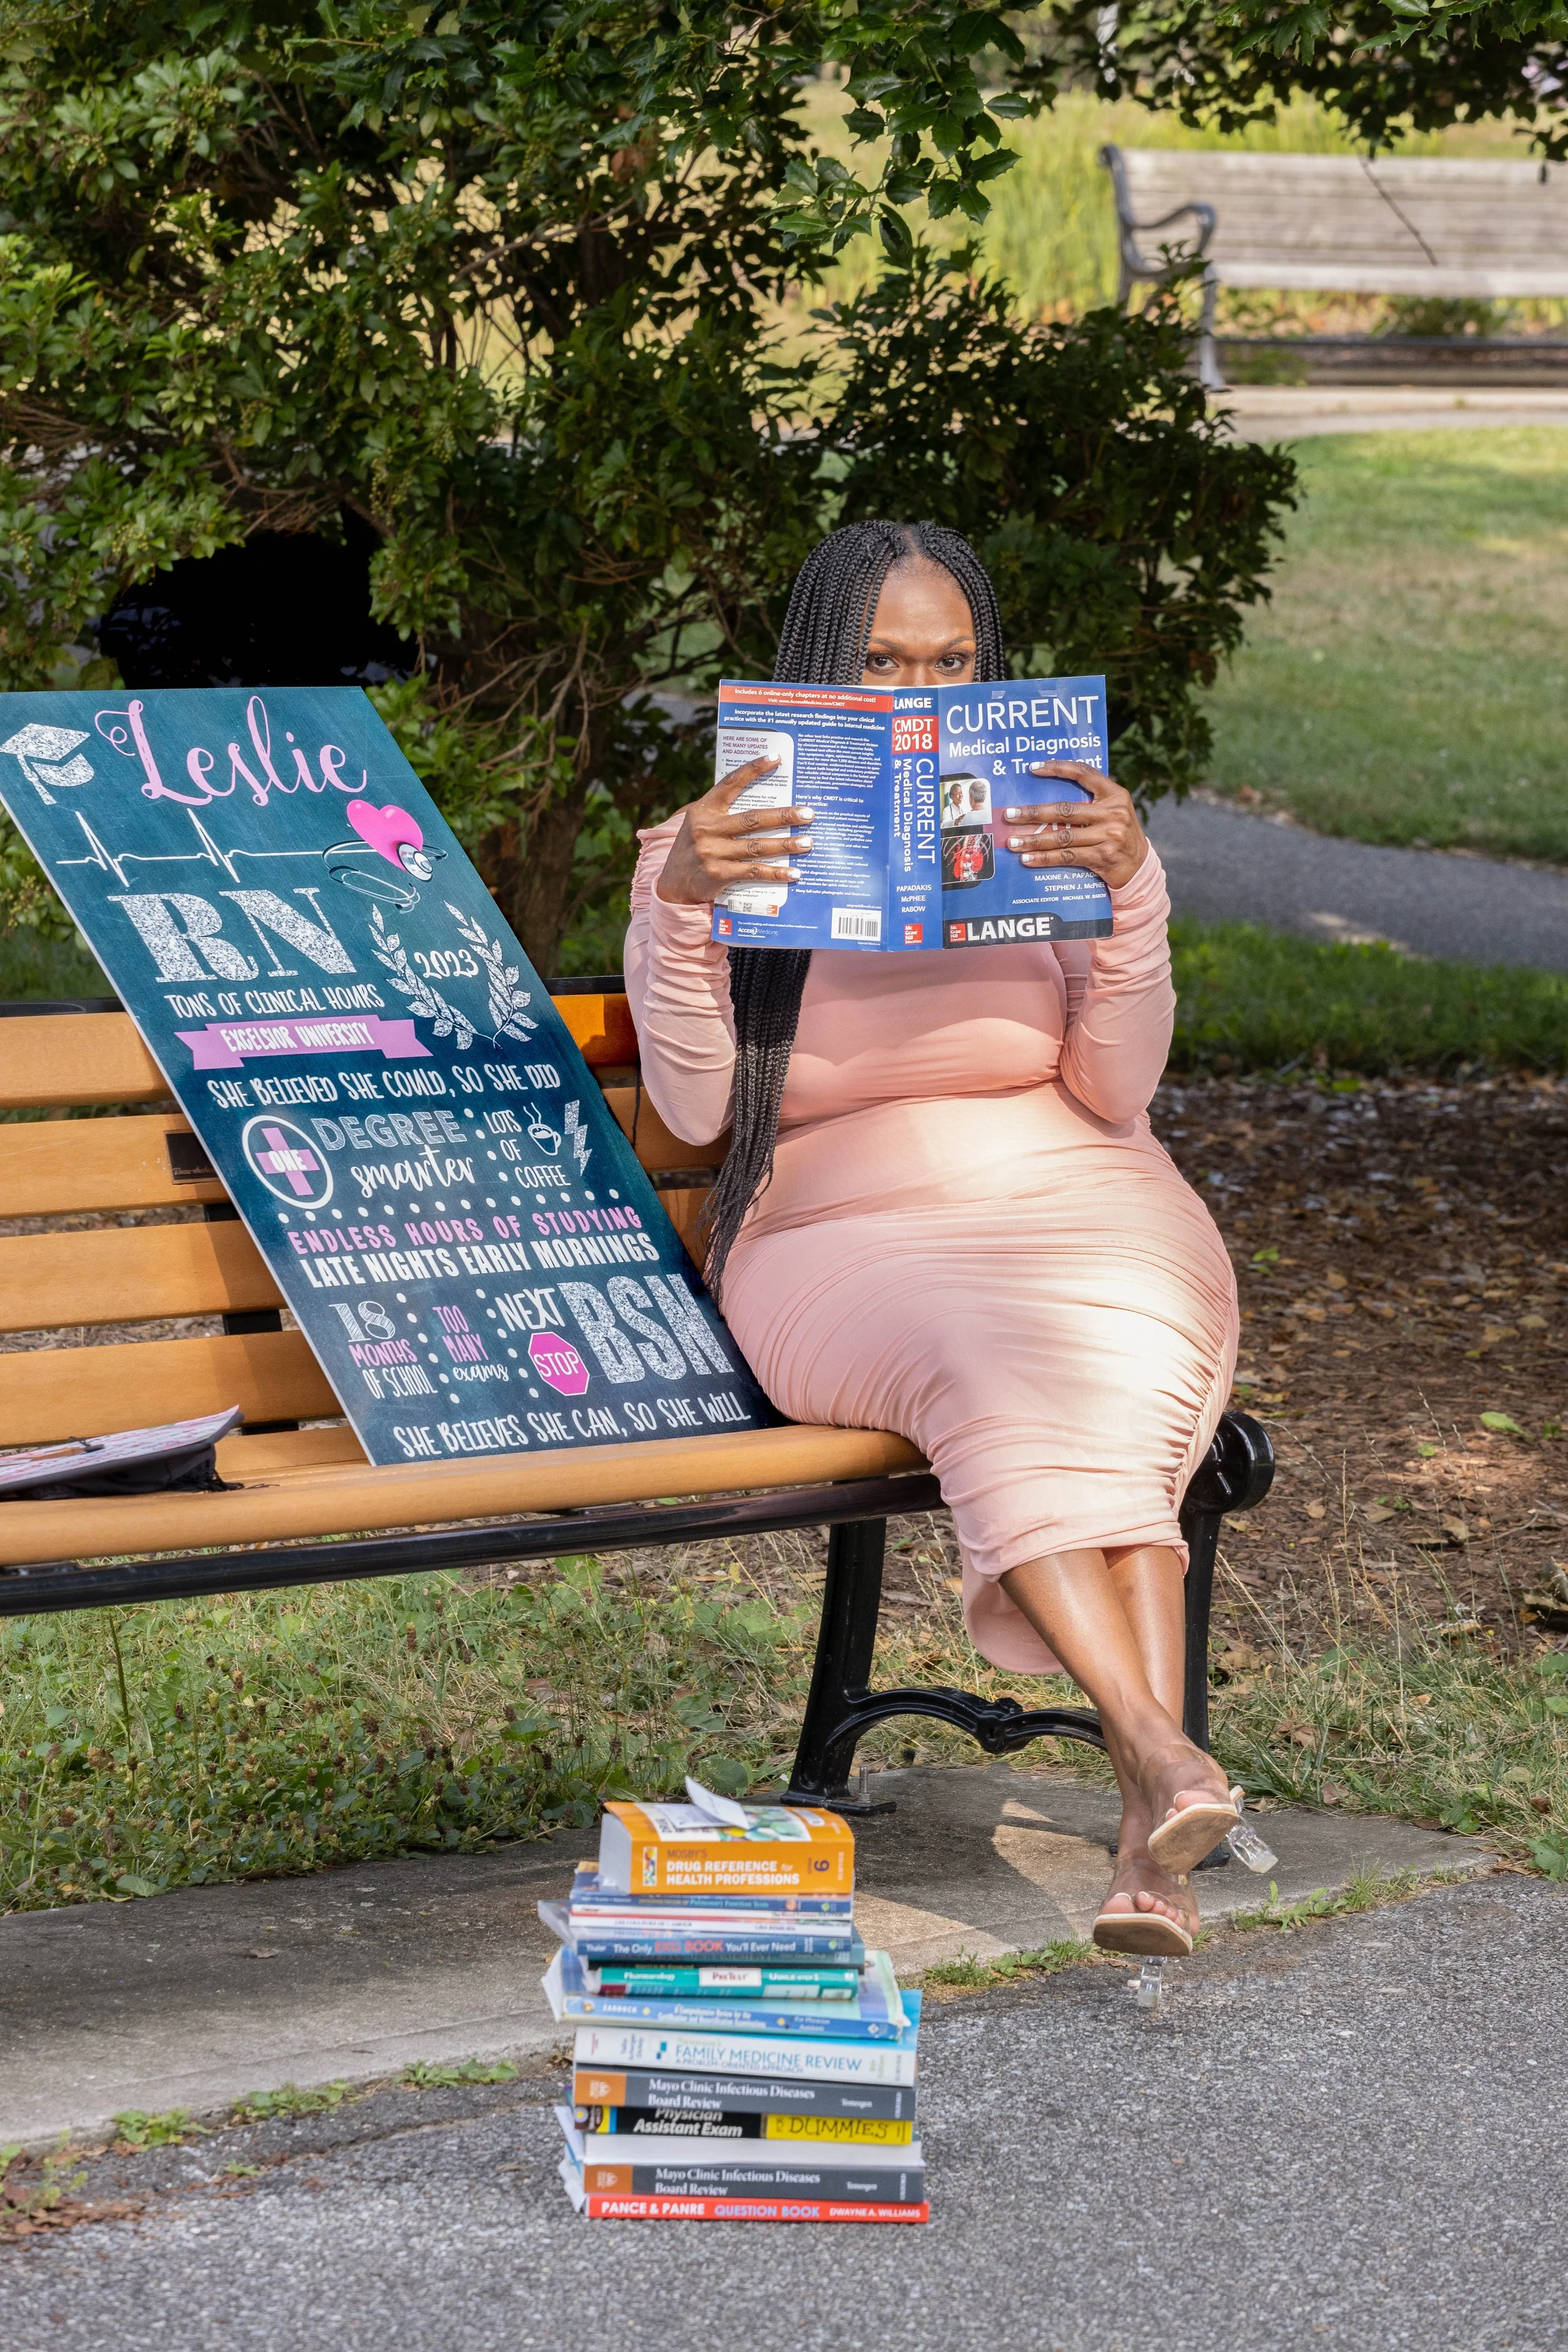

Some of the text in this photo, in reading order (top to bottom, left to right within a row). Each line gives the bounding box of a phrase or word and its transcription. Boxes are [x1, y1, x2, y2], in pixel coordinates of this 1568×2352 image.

[894, 697, 931, 709] LANGE
[946, 695, 1099, 734] CURRENT
[894, 719, 933, 733] CMDT
[95, 696, 367, 807] Leslie
[894, 733, 933, 751] 2018
[949, 733, 1101, 758] Medical Diagnosis
[894, 759, 902, 770] &
[992, 760, 1007, 776] &
[902, 758, 914, 872] Medical Diagnosis
[916, 758, 935, 864] CURRENT
[107, 887, 357, 983] RN
[967, 916, 1051, 941] LANGE
[414, 949, 479, 979] 2023
[164, 983, 385, 1018] TONS OF CLINICAL HOURS
[220, 1022, 374, 1052] EXCELSIOR UNIVERSITY
[207, 1064, 561, 1108] SHE BELIEVED SHE COULD, SO SHE DID
[311, 1110, 467, 1151] DEGREE
[483, 1110, 522, 1134] LOTS
[268, 1150, 307, 1173] ONE
[500, 1139, 522, 1161] OF
[351, 1145, 475, 1198] smarter
[514, 1165, 571, 1189] COFFEE
[287, 1206, 642, 1255] ENDLESS HOURS OF STUDYING
[300, 1232, 659, 1288] LATE NIGHTS EARLY MORNINGS
[328, 1301, 396, 1342] 18
[433, 1305, 469, 1333] TOO
[495, 1288, 565, 1332] NEXT
[556, 1273, 734, 1384] BSN
[348, 1338, 418, 1368] MONTHS
[442, 1333, 489, 1363] MANY
[453, 1364, 509, 1382] exams
[533, 1351, 580, 1377] STOP
[362, 1364, 438, 1399] OF SCHOOL
[393, 1392, 751, 1458] SHE BELIEVES SHE CAN, SO SHE WILL
[666, 1861, 701, 1872] DRUG
[704, 1860, 777, 1872] REFERENCE
[666, 1873, 799, 1885] HEALTH PROFESSIONS
[613, 1944, 629, 1953] The
[631, 1944, 652, 1954] Only
[684, 1939, 723, 1952] BOOK
[725, 1942, 749, 1952] You'll
[750, 1942, 769, 1952] Ever
[771, 1941, 796, 1951] Need
[676, 2043, 726, 2060] FAMILY
[729, 2047, 801, 2066] MEDICINE
[805, 2055, 862, 2071] REVIEW
[649, 2078, 815, 2099] Mayo Clinic Infectious Diseases
[648, 2094, 721, 2109] Board Review
[655, 2107, 723, 2122] Physician
[633, 2119, 743, 2137] Assistant Exam
[789, 2116, 888, 2139] DUMMIES
[655, 2168, 820, 2183] Mayo Clinic Infectious Diseases
[655, 2183, 728, 2196] Board Review
[601, 2201, 647, 2214] PANCE
[649, 2203, 659, 2214] &
[662, 2203, 704, 2215] PANRE
[714, 2205, 777, 2217] QUESTION
[781, 2206, 820, 2217] BOOK
[829, 2207, 867, 2216] DWAYNE
[877, 2208, 921, 2218] WILLIAMS
